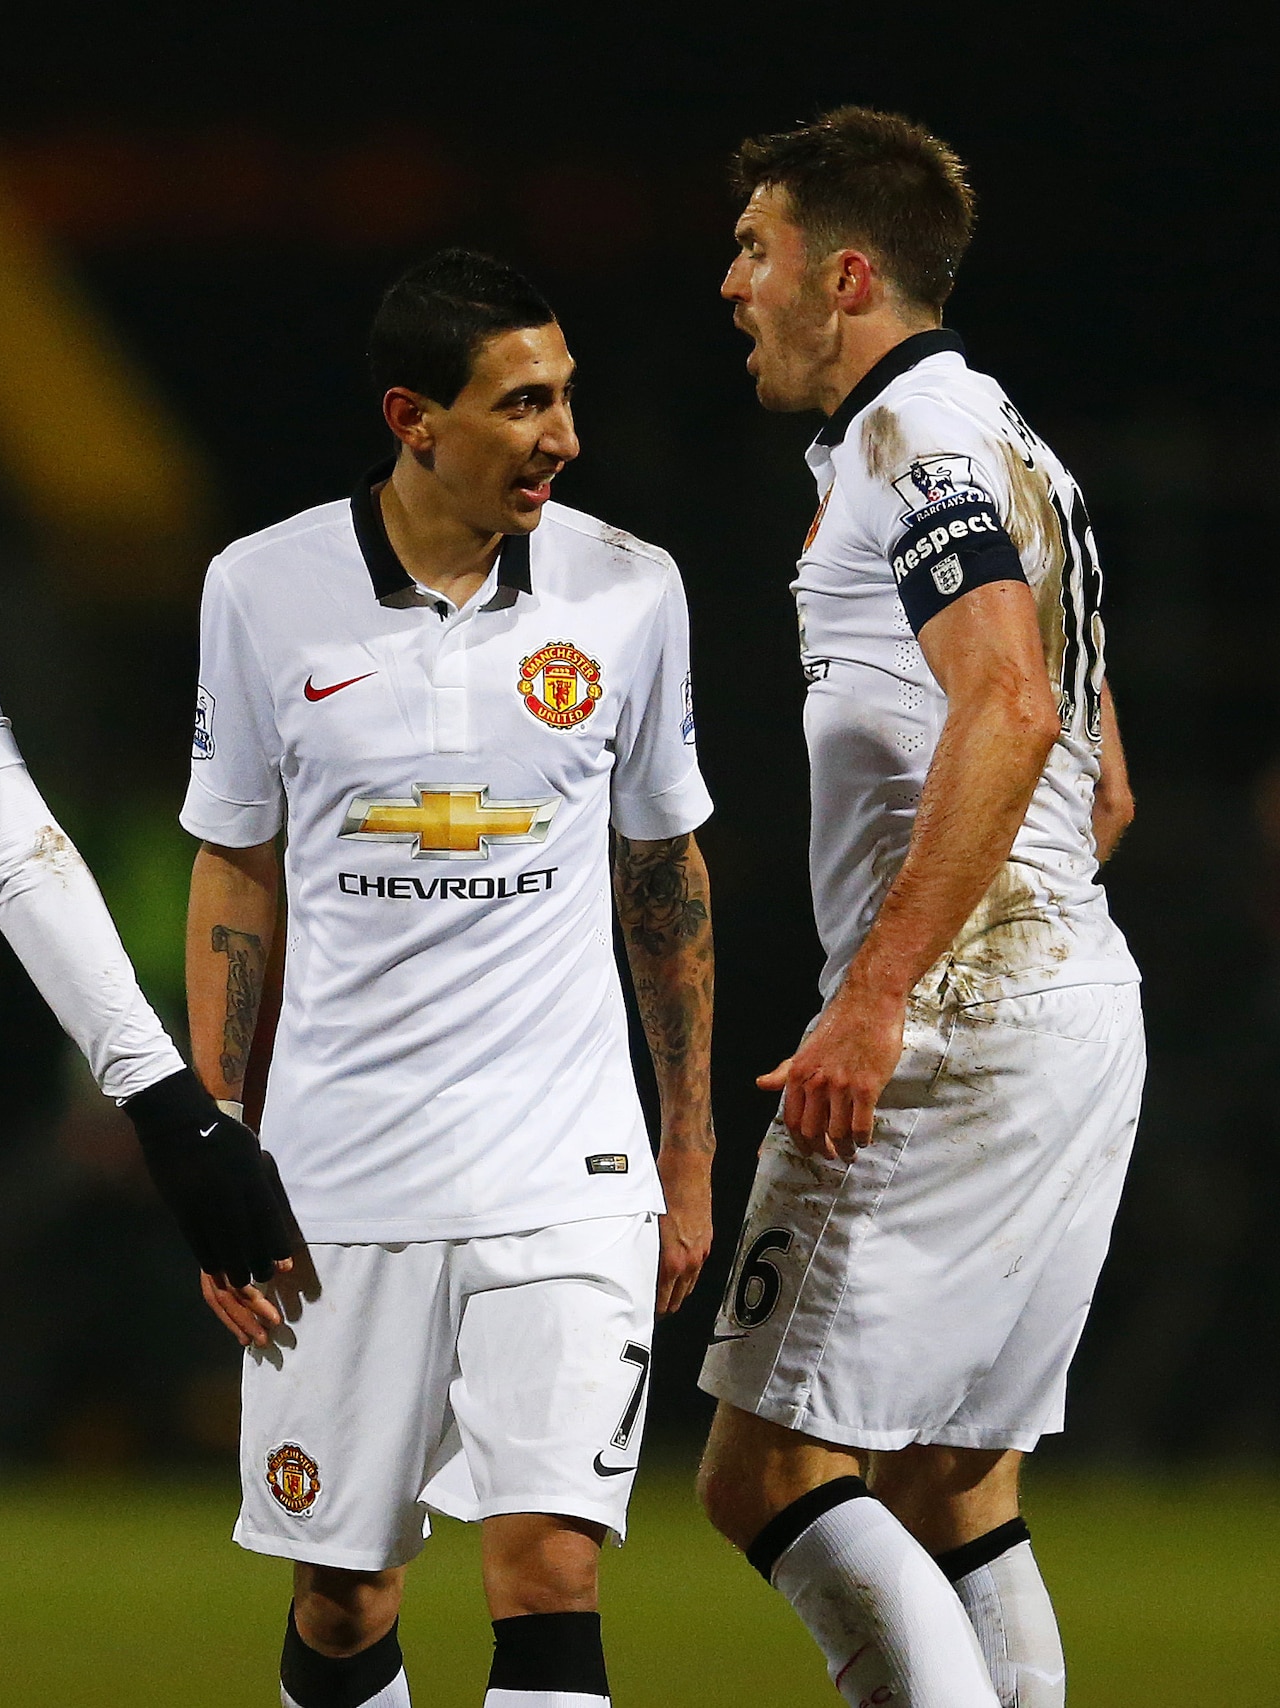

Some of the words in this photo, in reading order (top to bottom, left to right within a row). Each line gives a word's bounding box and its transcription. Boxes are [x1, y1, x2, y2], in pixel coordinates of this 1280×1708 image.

[892, 511, 998, 585] Respect
[526, 647, 595, 679] MANCHESTER
[537, 706, 584, 723] UNITED
[339, 867, 558, 899] CHEVROLET
[610, 1340, 651, 1451] 7
